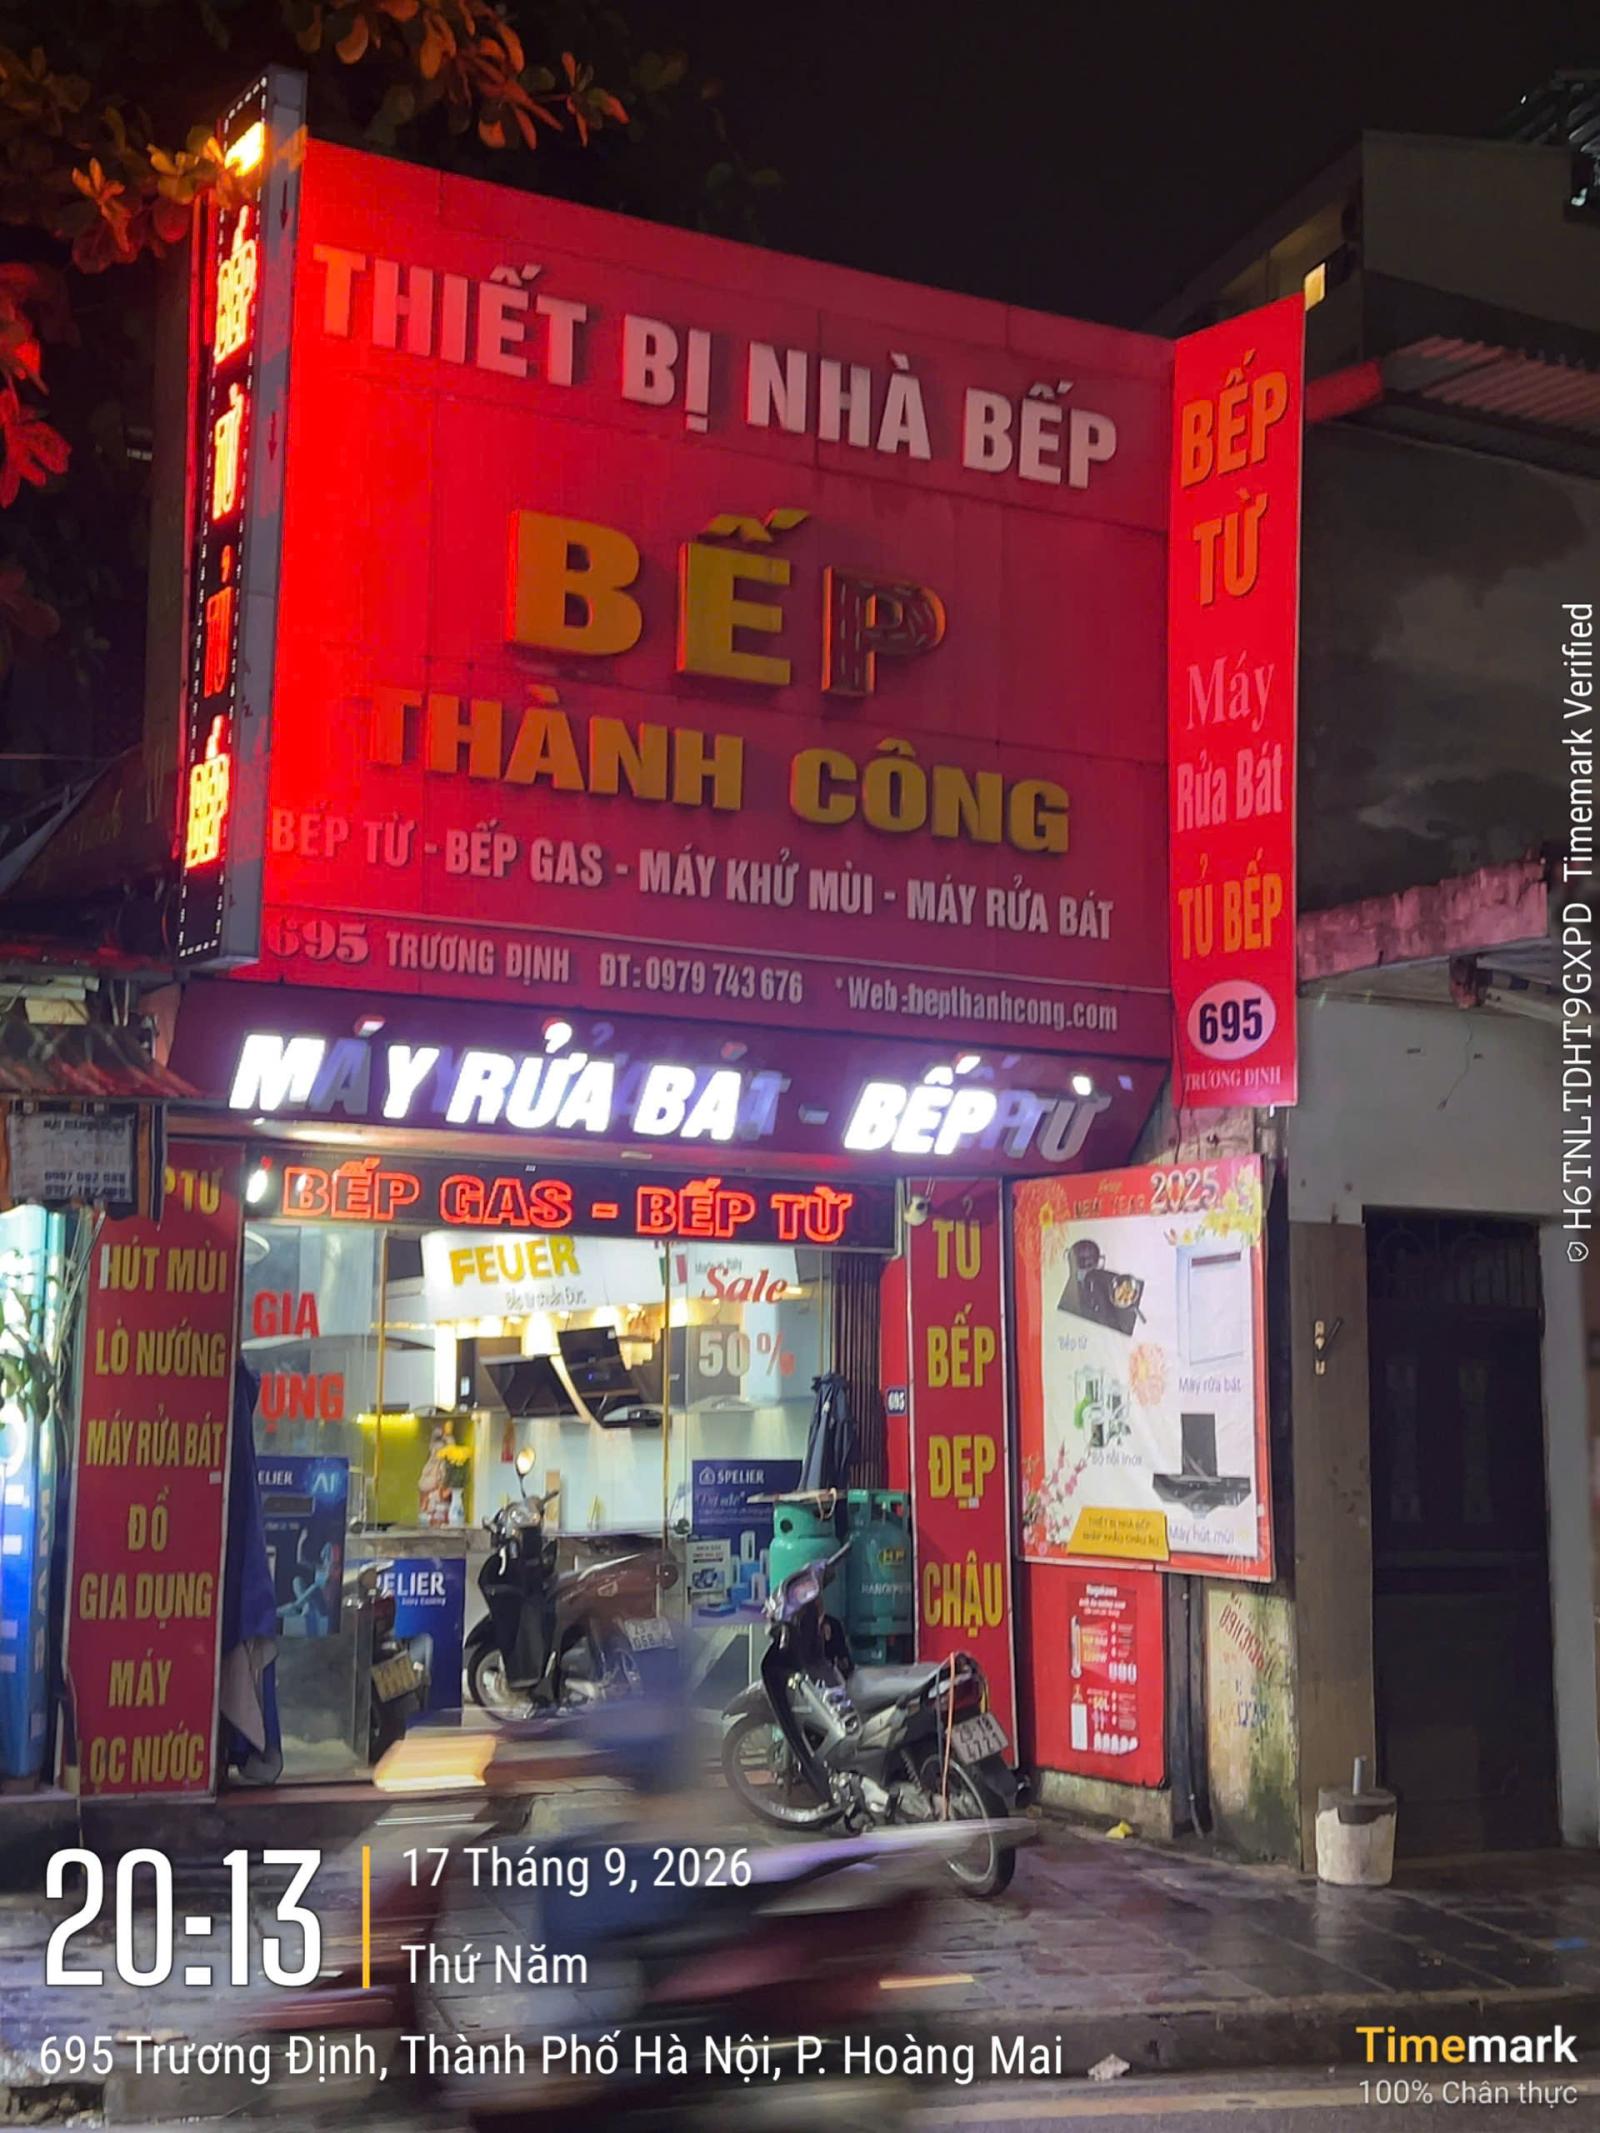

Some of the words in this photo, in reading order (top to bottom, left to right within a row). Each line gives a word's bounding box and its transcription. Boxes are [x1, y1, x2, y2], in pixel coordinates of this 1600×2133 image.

[313, 244, 587, 387] THIẾT
[621, 314, 711, 433] BỊ
[746, 341, 931, 461] NHÀ
[962, 380, 1117, 490] BẾP
[1180, 349, 1290, 489] BẾP
[1194, 489, 1269, 609] TỪ
[505, 508, 947, 697] BẾP
[1186, 649, 1276, 732] Máy
[369, 684, 743, 811] THÀNH
[791, 738, 1070, 854] CÔNG
[1177, 751, 1228, 833] Rửa
[1236, 742, 1283, 820] Bát
[271, 799, 350, 857] BẾP
[363, 811, 416, 868] TỪ
[445, 817, 518, 878] BẾP
[531, 837, 603, 888] GAS
[639, 843, 716, 898] MÁY
[726, 846, 799, 907] KHỬ
[808, 859, 874, 915] MÙI
[907, 874, 978, 926] MÁY
[986, 873, 1049, 935] RỬA
[1059, 889, 1114, 941] BÁT
[1178, 853, 1213, 961] TỦ
[1223, 847, 1283, 953] BẾP
[267, 915, 370, 964] 695
[386, 929, 496, 976] TRƯƠNG
[505, 942, 570, 985] ĐỊNH
[713, 963, 755, 1000] 743
[761, 966, 804, 1004] 676
[1200, 998, 1263, 1045] 695
[229, 1015, 440, 1120] MÁY
[446, 1020, 615, 1133] RỬA
[843, 1055, 998, 1156] BẾP
[283, 1157, 421, 1220] BẾP
[439, 1174, 574, 1229] GAS
[636, 1177, 756, 1239] BẾP
[771, 1186, 853, 1243] TỪ
[1151, 1165, 1220, 1216] 2025
[99, 1235, 161, 1292] HÚT
[166, 1240, 228, 1294] MÙI
[449, 1235, 581, 1288] FEUER
[932, 1194, 981, 1280] TỦ
[252, 1290, 320, 1338] GIA
[700, 1267, 789, 1305] Sale
[95, 1318, 130, 1376] LÒ
[136, 1317, 226, 1378] NƯỚNG
[928, 1304, 997, 1388] BẾP
[86, 1409, 134, 1467] MÁY
[136, 1403, 181, 1467] RỬA
[184, 1411, 224, 1468] BÁT
[260, 1372, 345, 1434] ỤNG
[928, 1435, 997, 1509] ĐẸP
[128, 1486, 170, 1552] ĐỒ
[80, 1573, 128, 1621] GIA
[135, 1573, 214, 1630] DỤNG
[923, 1550, 1002, 1638] CHẬU
[109, 1648, 172, 1708] MÁY
[132, 1721, 205, 1784] NƯỚC
